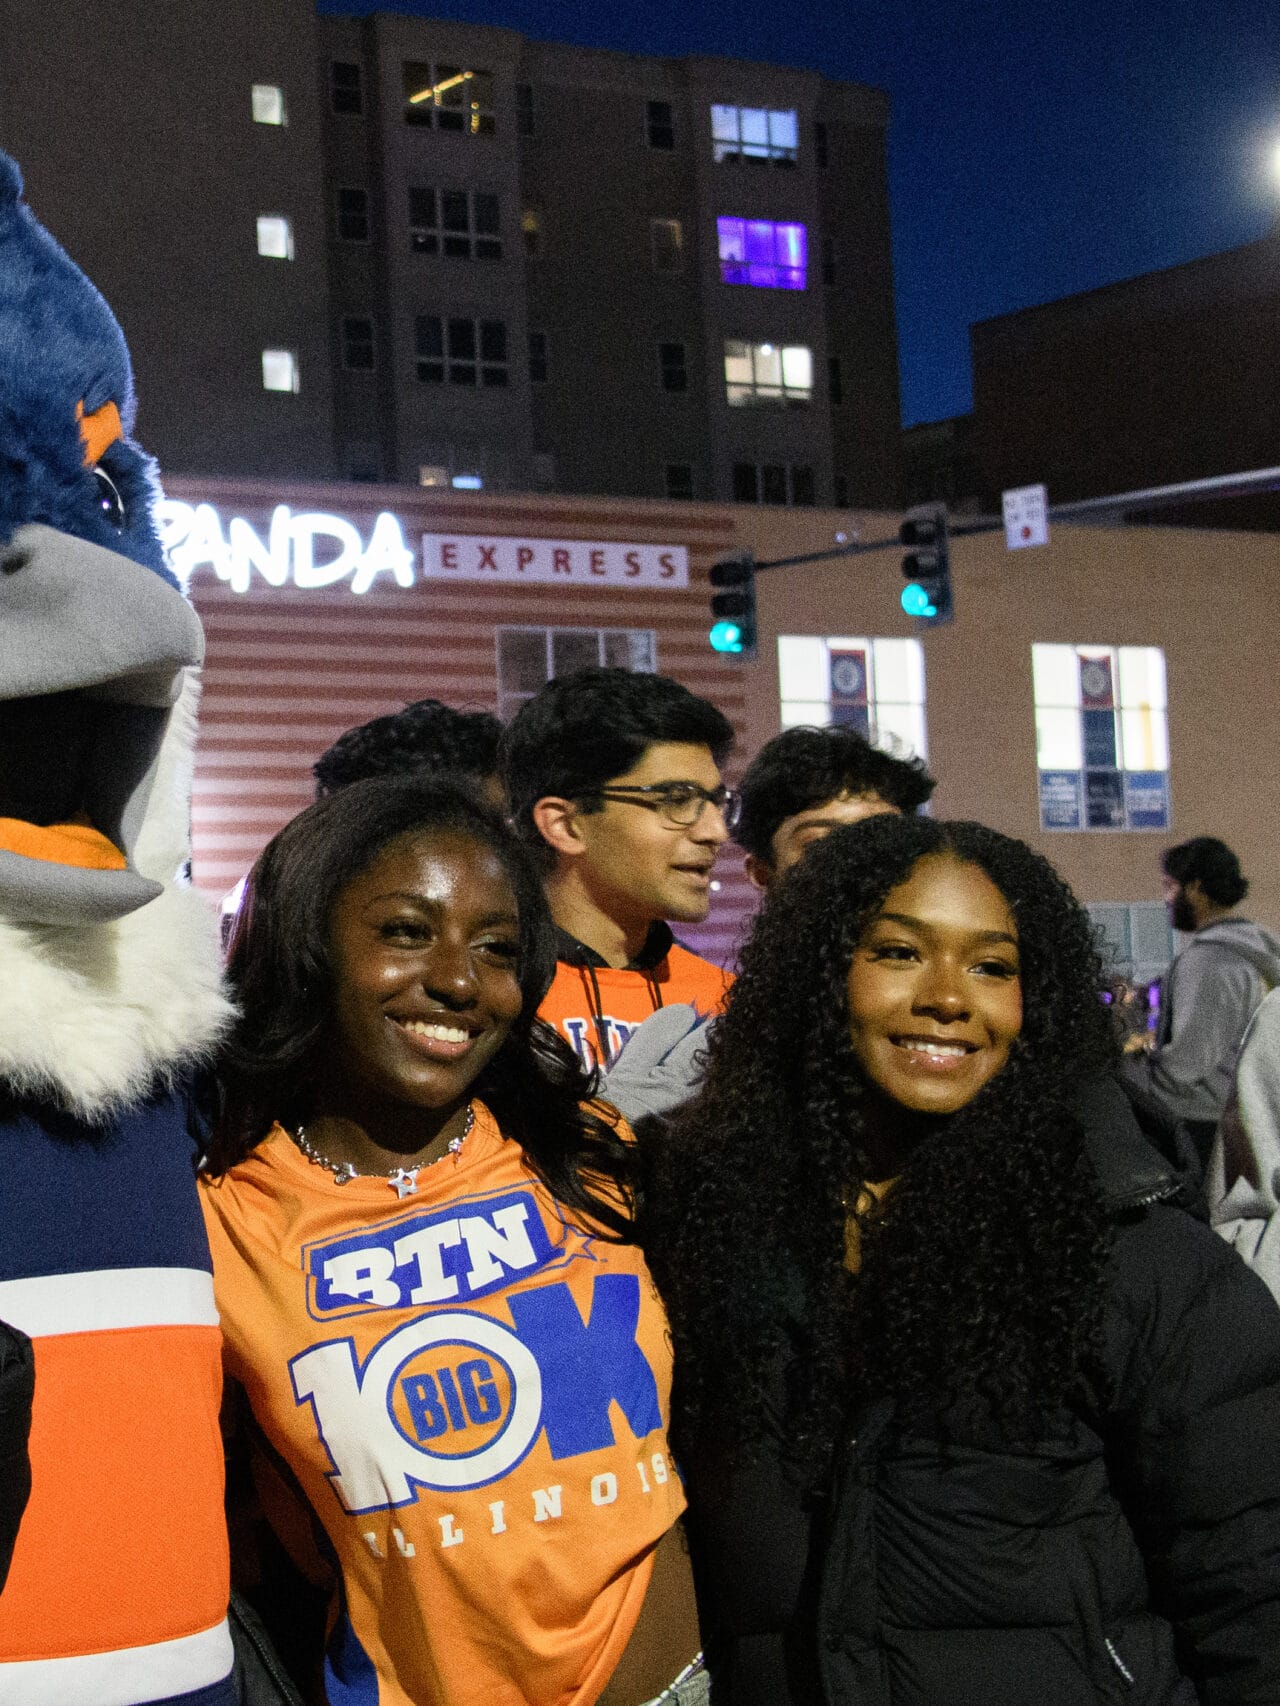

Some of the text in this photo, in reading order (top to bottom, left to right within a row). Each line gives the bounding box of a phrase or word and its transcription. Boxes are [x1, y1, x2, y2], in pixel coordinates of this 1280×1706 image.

[440, 543, 675, 578] EXPRESS
[323, 1203, 538, 1306] BTN
[402, 1359, 502, 1441] BIG
[364, 1452, 669, 1558] ILLINOIS
